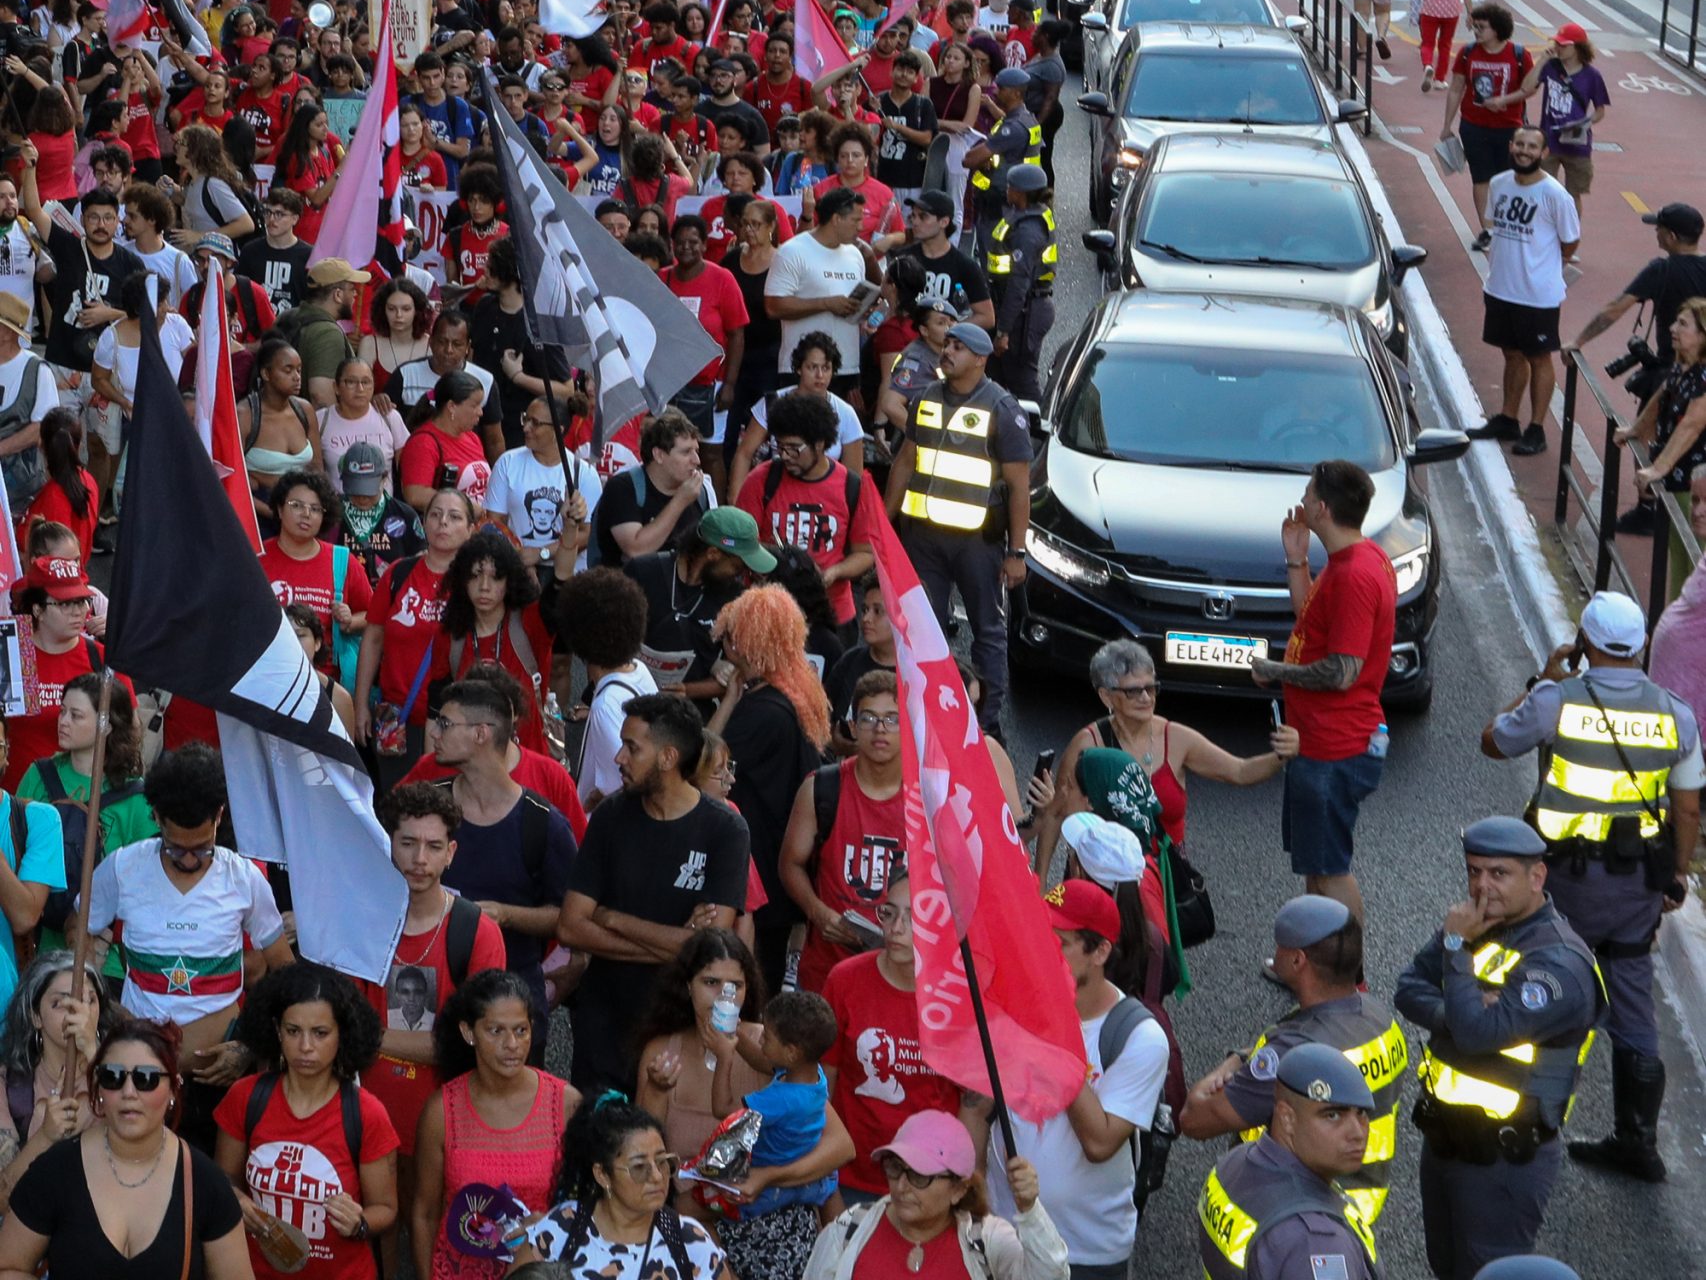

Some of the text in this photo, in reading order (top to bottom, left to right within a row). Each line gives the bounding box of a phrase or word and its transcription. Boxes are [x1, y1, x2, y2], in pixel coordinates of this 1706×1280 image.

[265, 261, 292, 290] UP
[1176, 644, 1255, 665] ELE4H26
[1581, 715, 1664, 738] POLICIA
[894, 1063, 917, 1075] Olga
[1359, 1041, 1405, 1080] POLICIA
